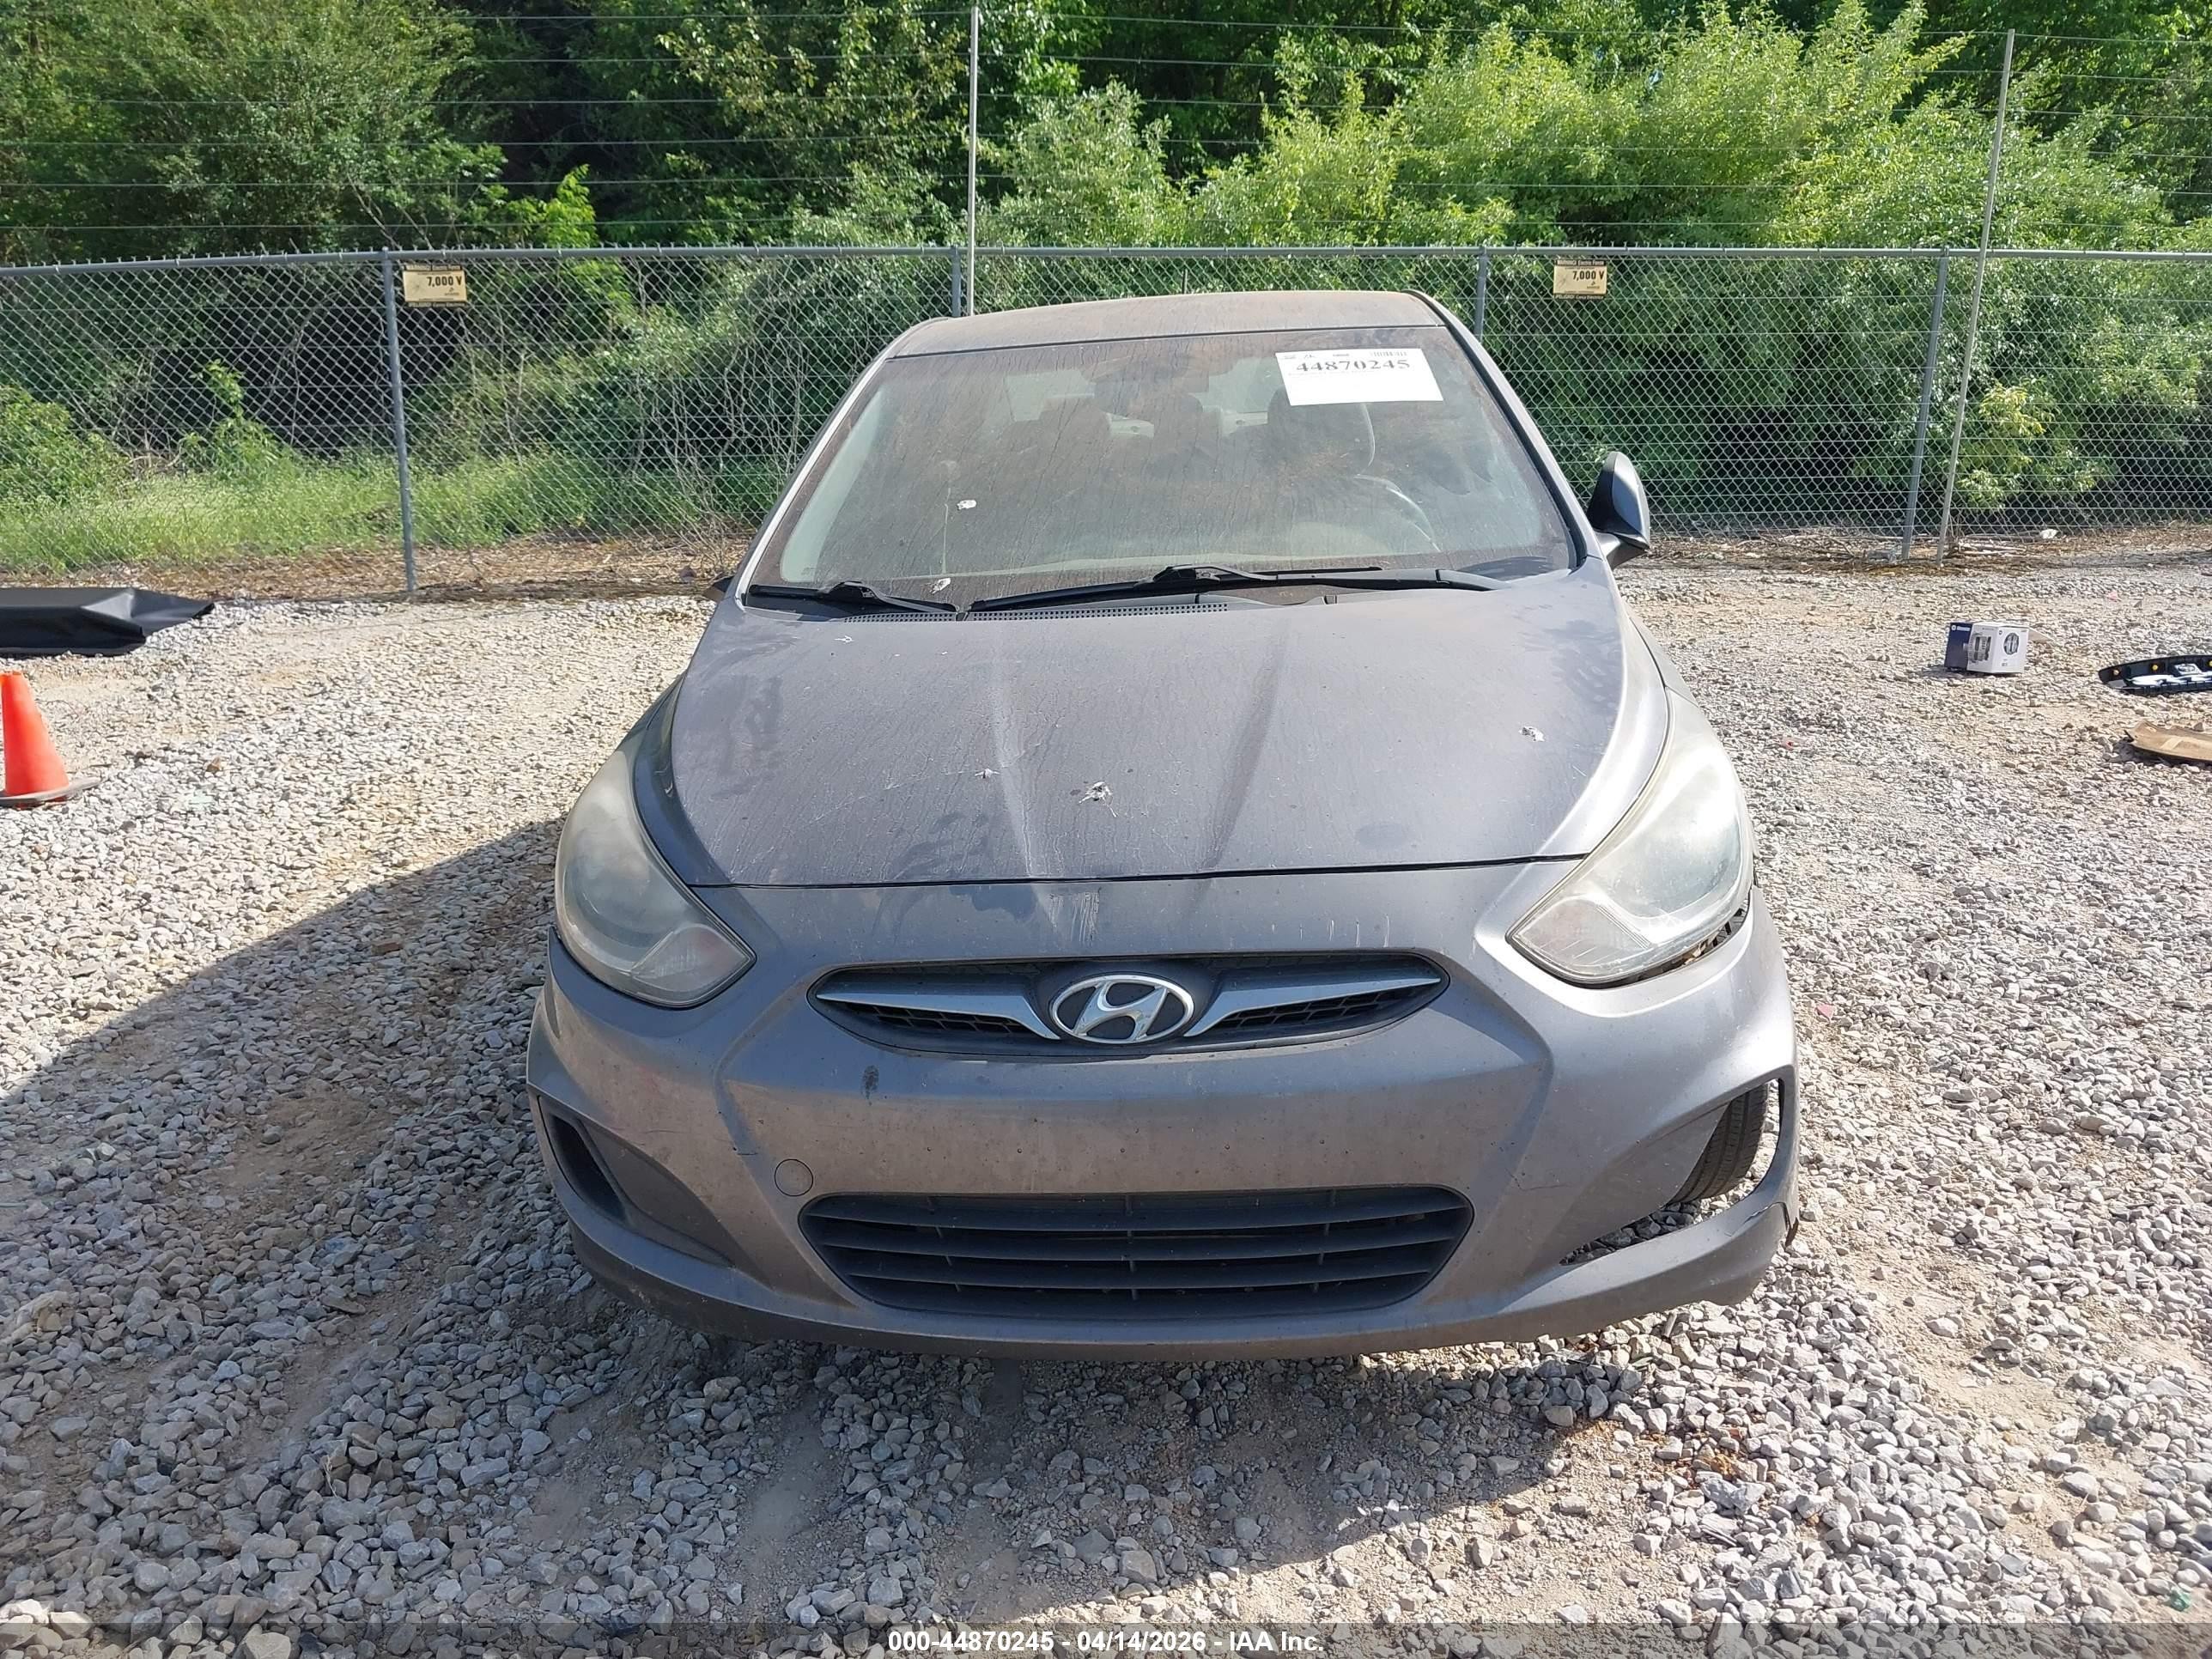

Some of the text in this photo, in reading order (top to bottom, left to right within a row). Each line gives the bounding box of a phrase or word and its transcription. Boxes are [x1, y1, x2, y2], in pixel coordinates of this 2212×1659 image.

[1572, 270, 1604, 281] 7,000 V
[426, 276, 462, 288] 7,000 V
[1296, 359, 1410, 371] 44870245
